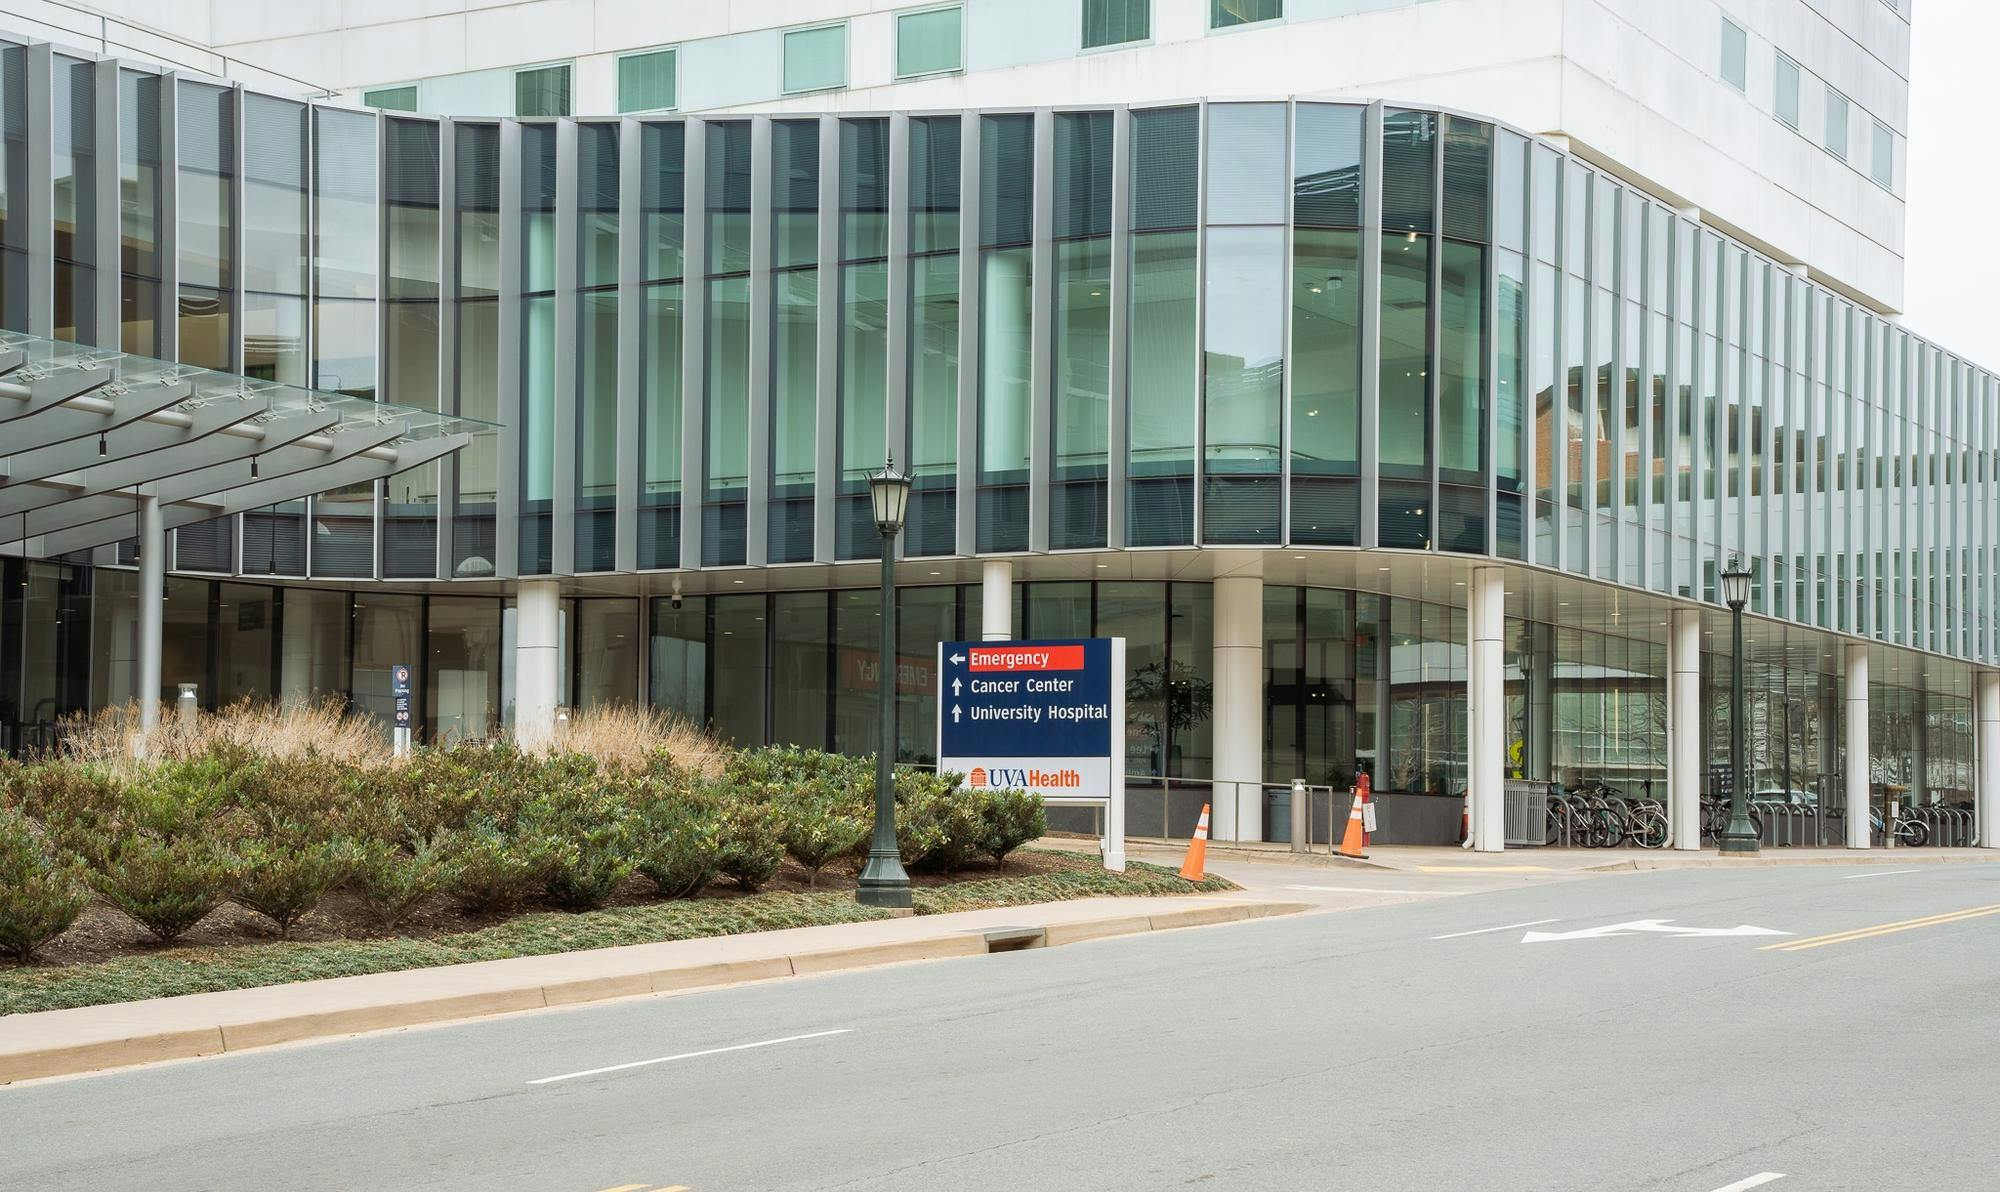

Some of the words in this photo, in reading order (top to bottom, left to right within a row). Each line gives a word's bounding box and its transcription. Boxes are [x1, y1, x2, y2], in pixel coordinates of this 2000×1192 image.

[970, 652, 1049, 669] Emergency
[970, 679, 1020, 693] Cancer
[1026, 678, 1074, 692] Center
[970, 705, 1042, 723] University
[1048, 703, 1108, 722] Hospital
